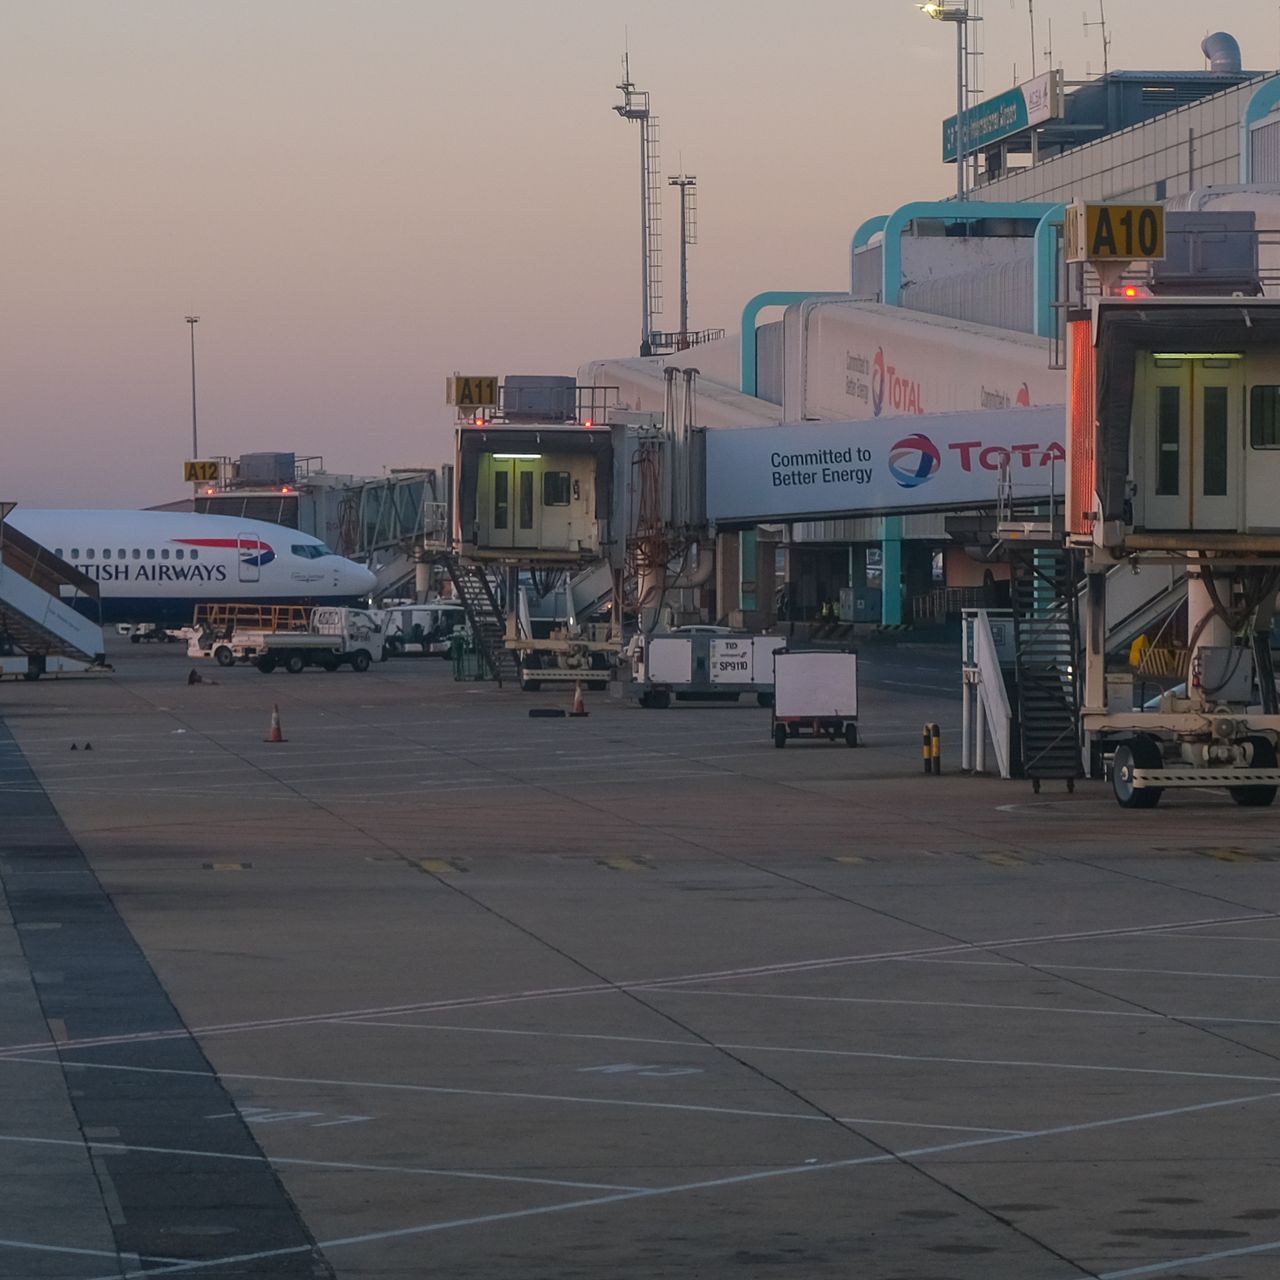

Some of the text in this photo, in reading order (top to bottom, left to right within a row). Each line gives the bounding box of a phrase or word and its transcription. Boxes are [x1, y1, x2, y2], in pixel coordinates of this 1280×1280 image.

[1092, 207, 1158, 256] A10
[460, 377, 494, 405] A11
[886, 366, 924, 415] TOTAL
[771, 448, 872, 468] Committed to
[948, 441, 1066, 472] TOTA
[187, 463, 218, 481] A12
[772, 468, 873, 487] Better Energy
[134, 564, 227, 582] AIRWAYS
